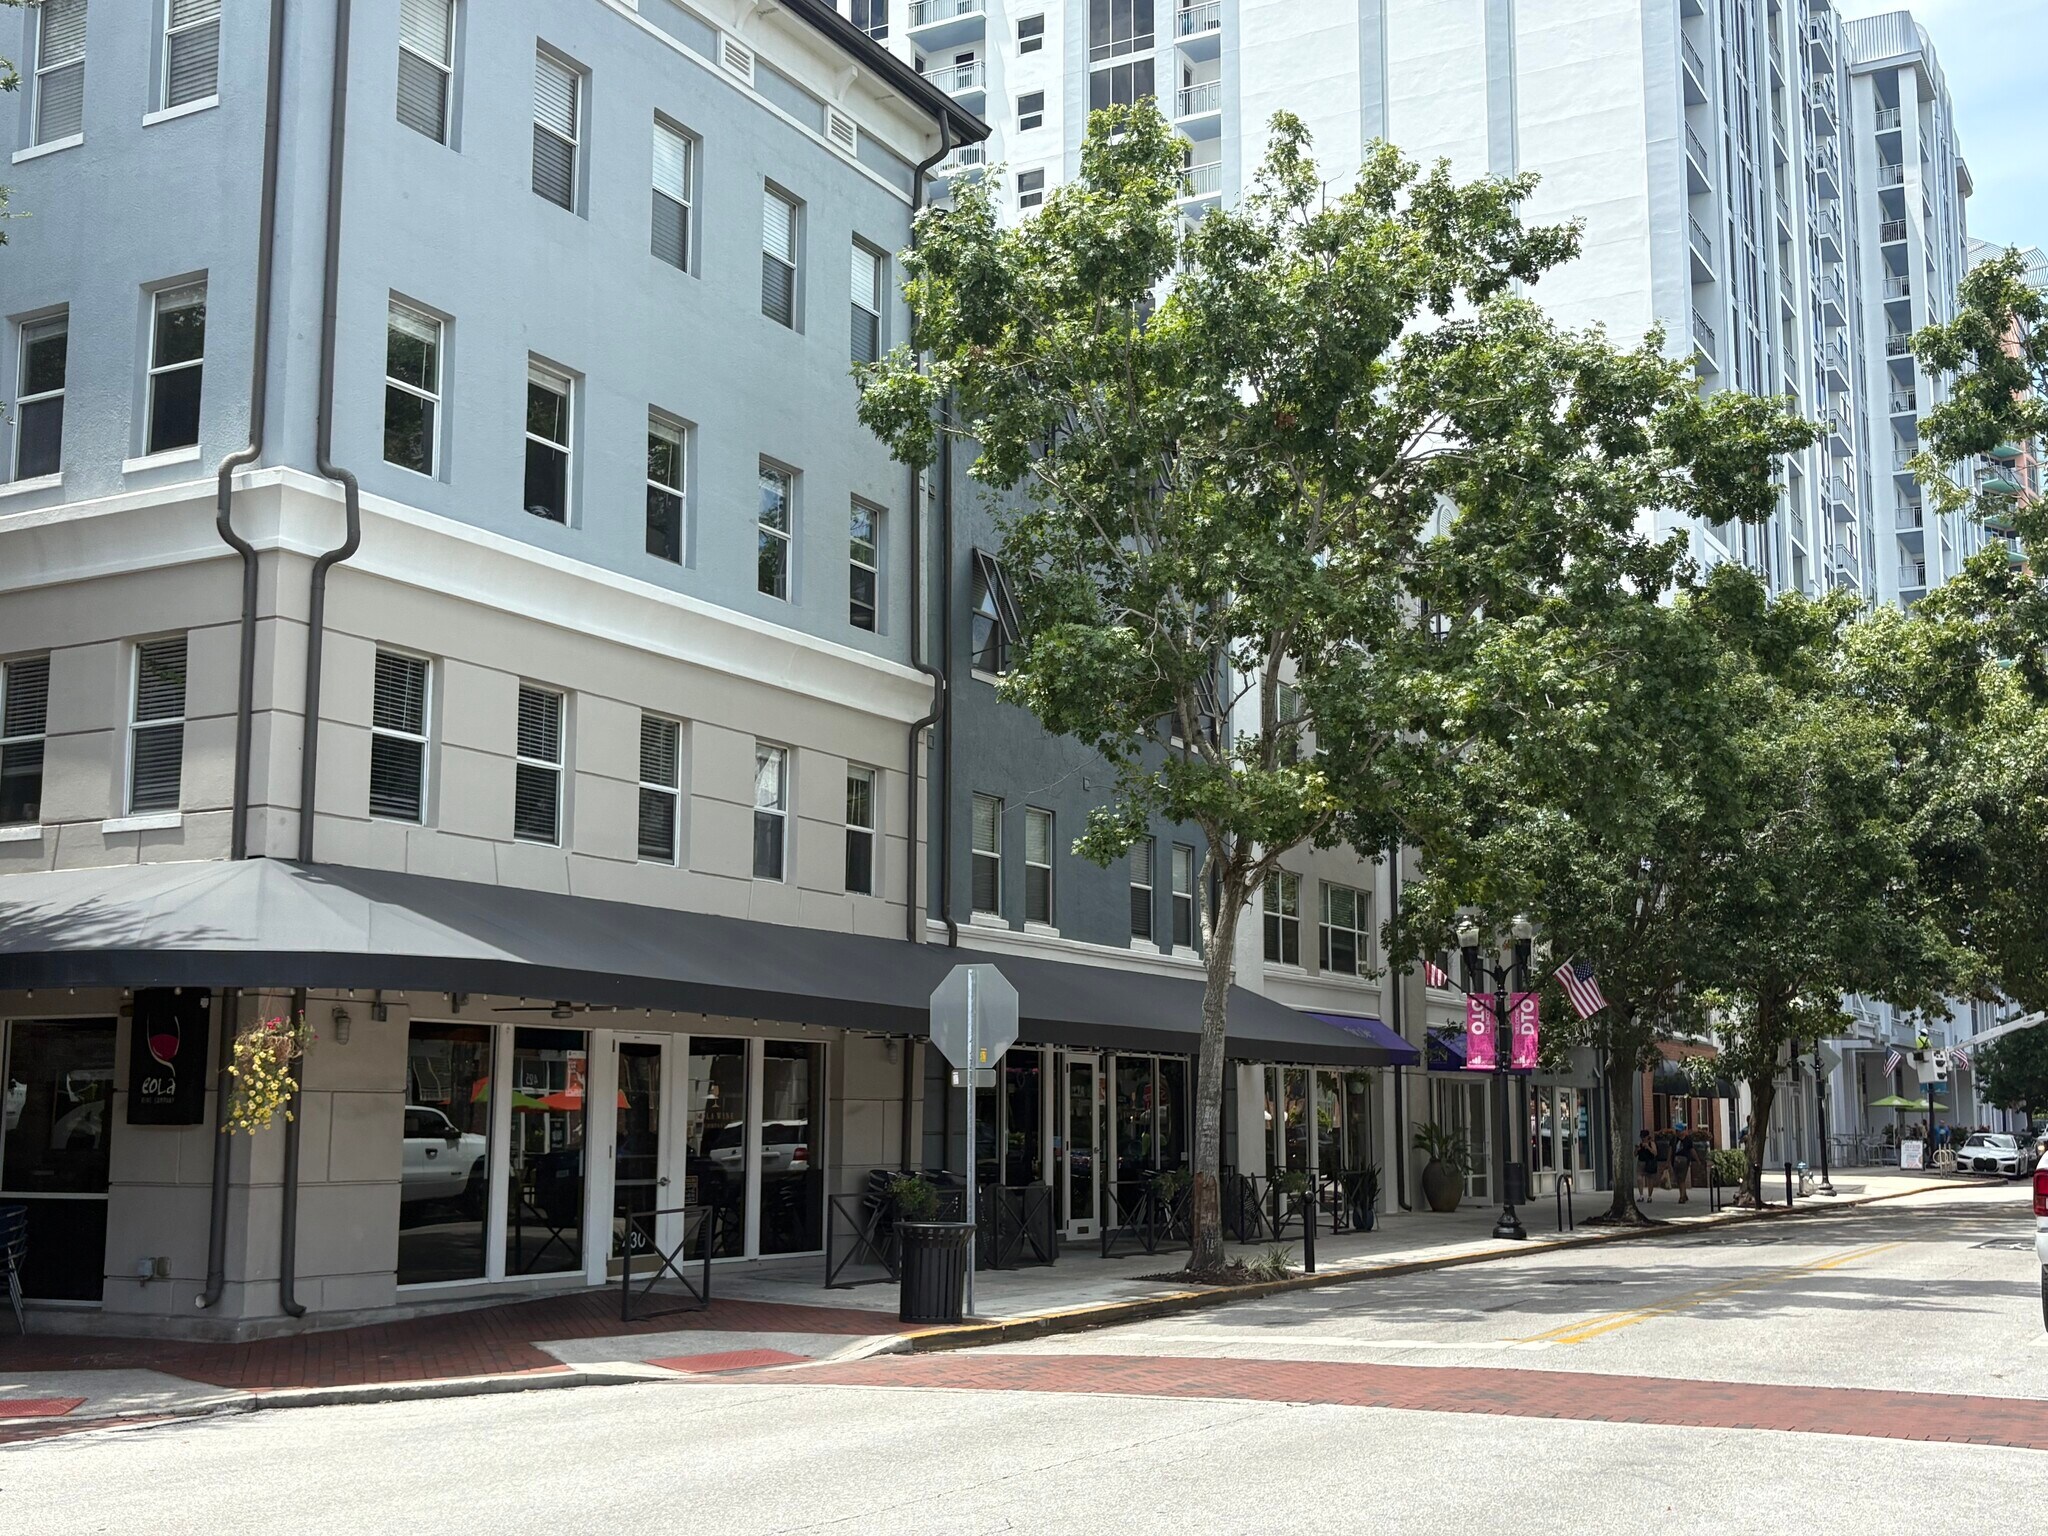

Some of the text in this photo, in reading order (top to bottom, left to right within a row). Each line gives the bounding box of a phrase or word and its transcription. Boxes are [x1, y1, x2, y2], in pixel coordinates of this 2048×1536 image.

[1471, 999, 1485, 1035] DTO
[1520, 999, 1534, 1035] DTO
[621, 1231, 646, 1249] 30
